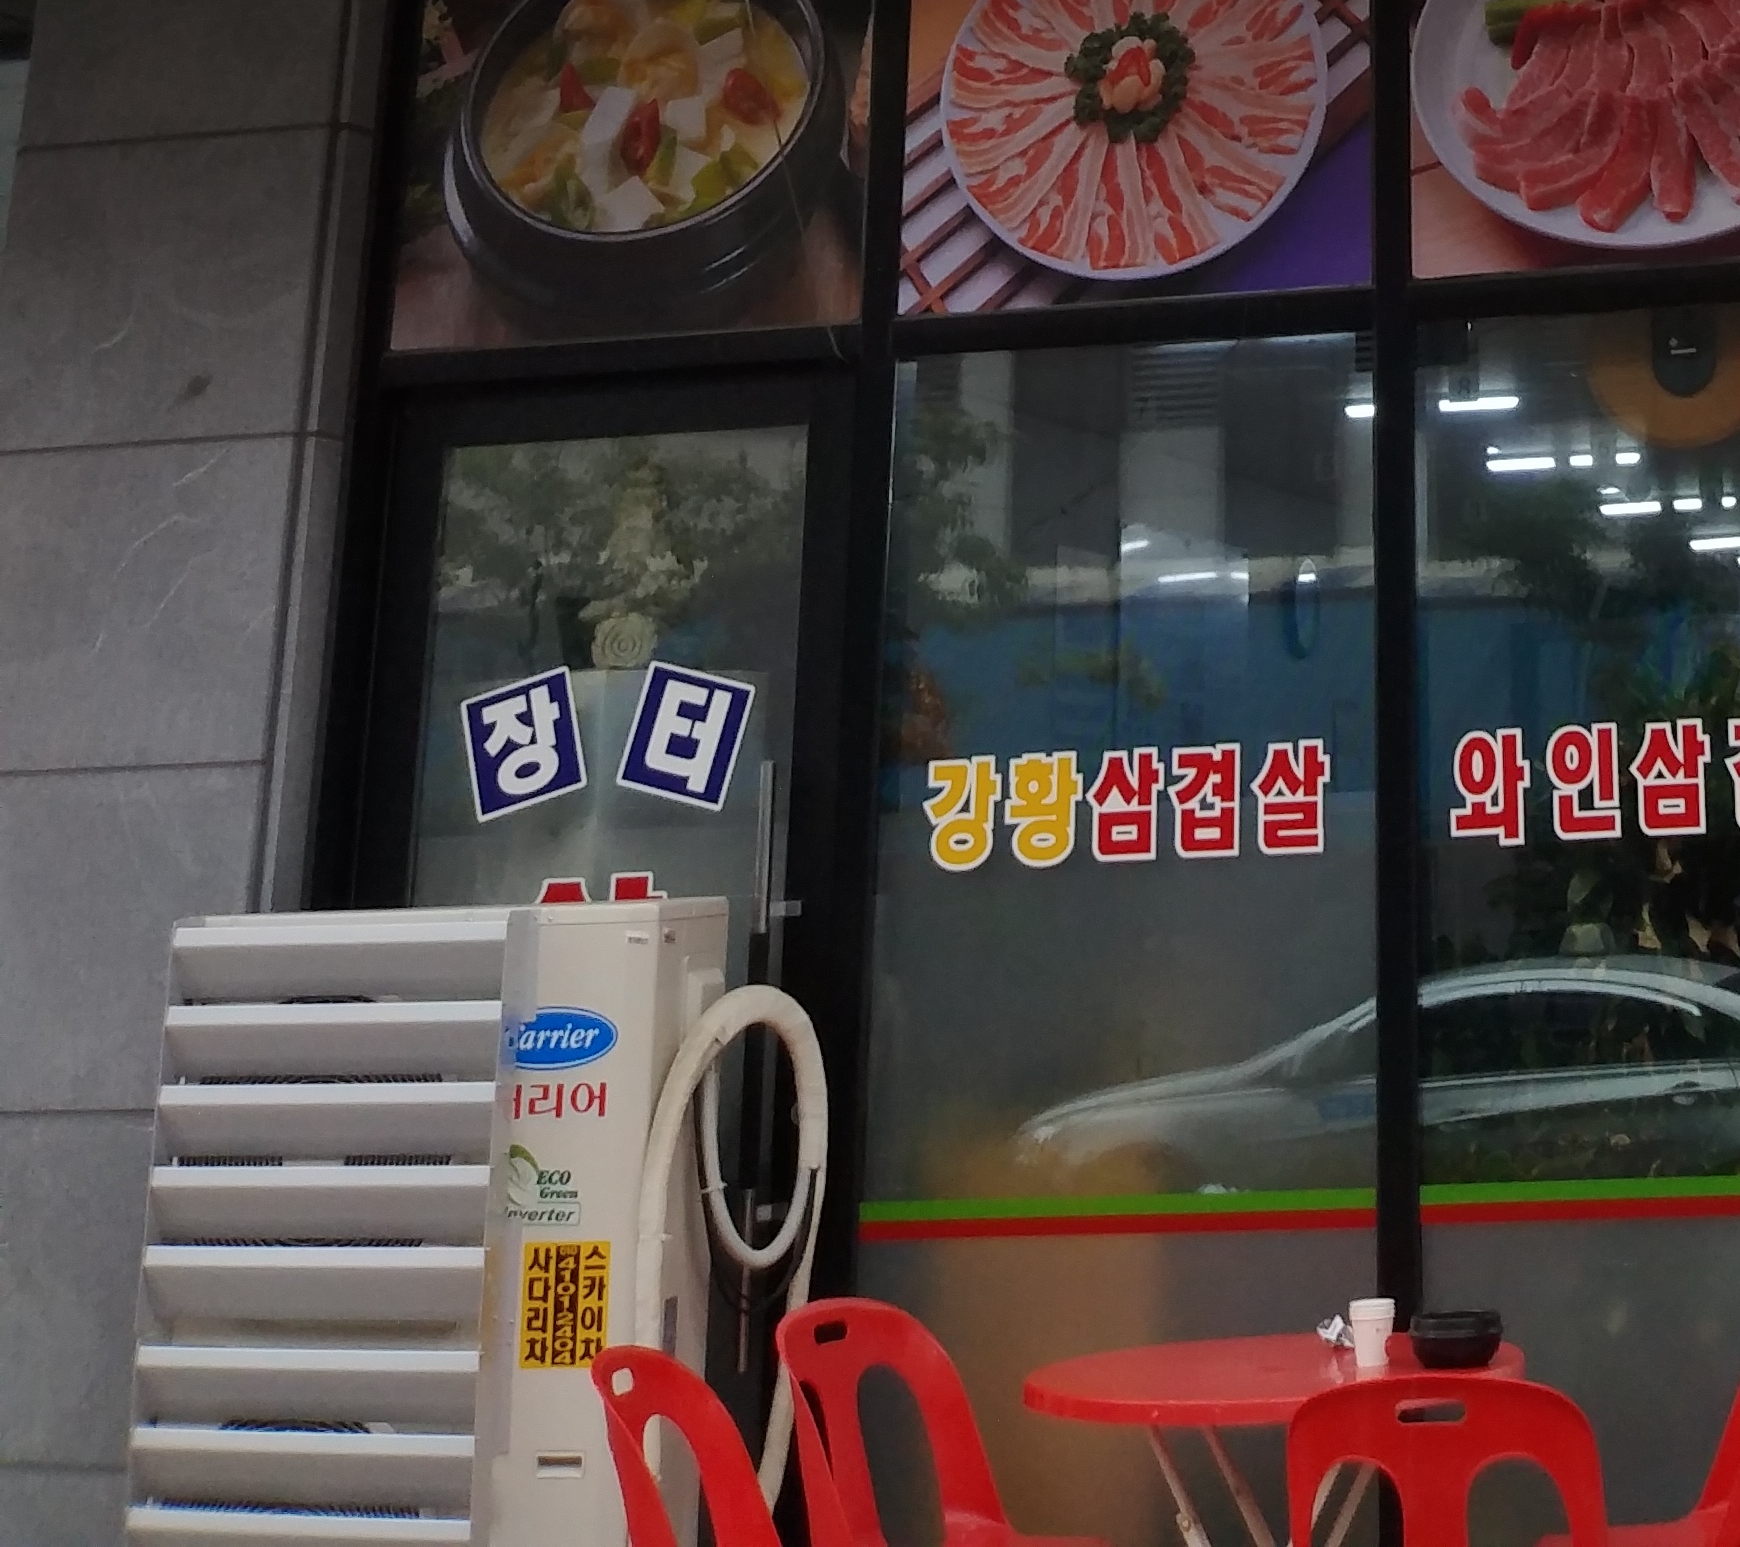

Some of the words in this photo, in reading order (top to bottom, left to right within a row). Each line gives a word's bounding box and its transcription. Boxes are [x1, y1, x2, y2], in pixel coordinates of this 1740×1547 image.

[922, 737, 1330, 872] 강황삼겹살
[536, 1169, 571, 1186] ECO
[539, 1186, 579, 1199] Green
[524, 1246, 553, 1365] 사다리차
